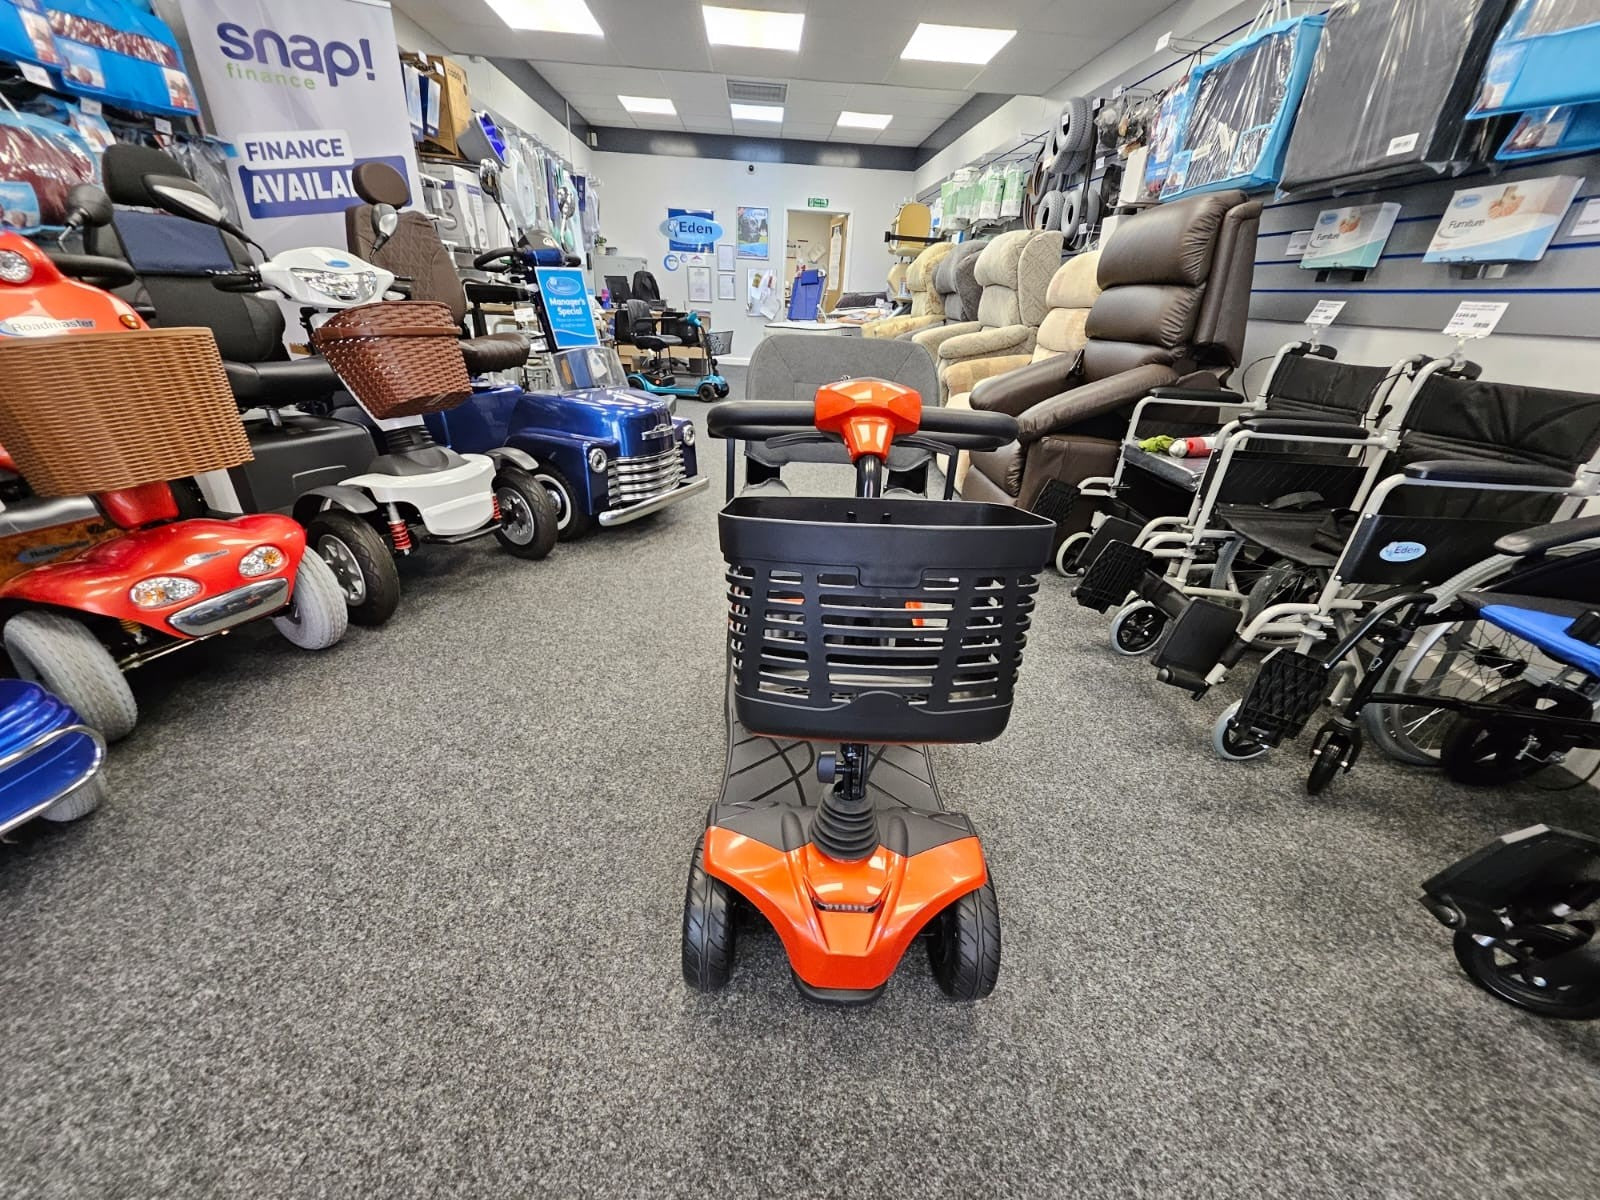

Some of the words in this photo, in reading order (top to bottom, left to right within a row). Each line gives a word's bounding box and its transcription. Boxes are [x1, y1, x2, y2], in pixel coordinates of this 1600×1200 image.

[216, 22, 375, 87] snap!
[226, 62, 316, 90] finance
[245, 138, 345, 162] FINANCE
[252, 169, 359, 204] AVAILA
[679, 221, 713, 235] Eden
[1448, 219, 1485, 229] Furniture
[549, 295, 586, 309] Manager's
[557, 306, 583, 317] Special
[11, 320, 94, 332] Roadmaster
[1394, 545, 1420, 554] Eden
